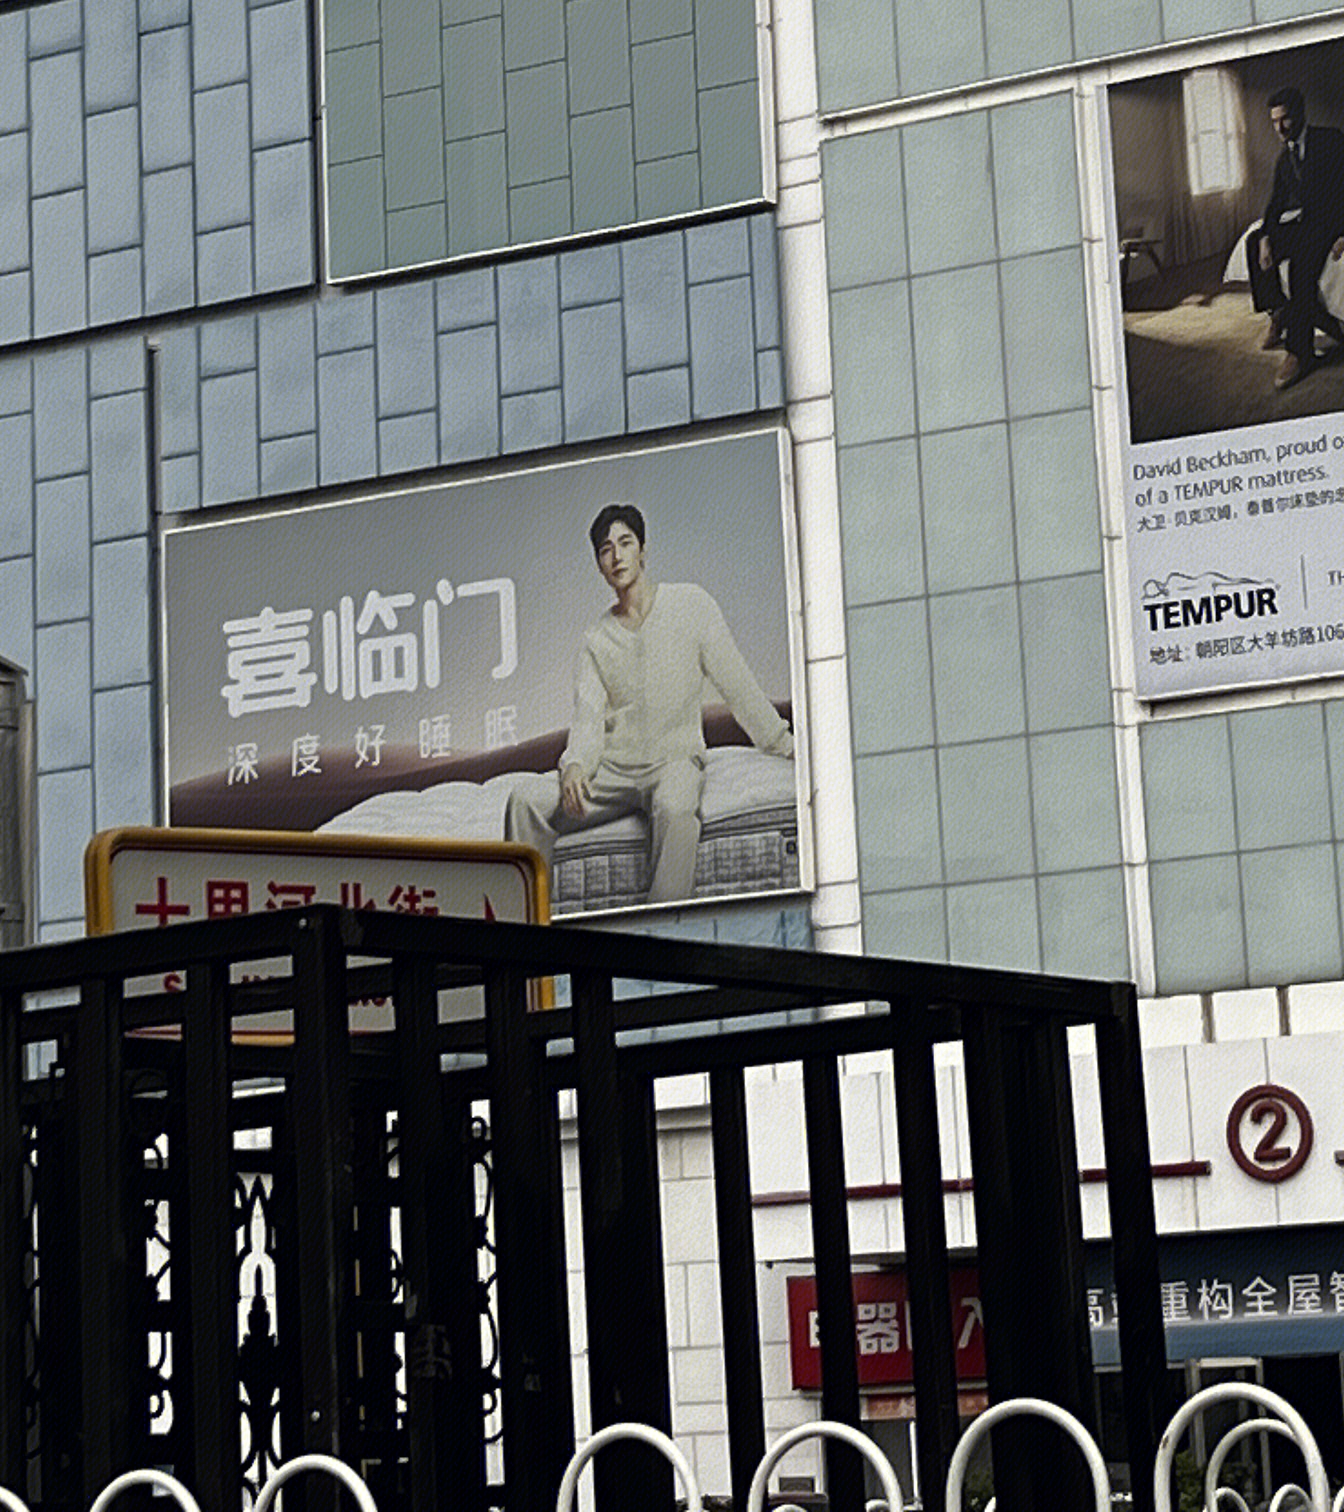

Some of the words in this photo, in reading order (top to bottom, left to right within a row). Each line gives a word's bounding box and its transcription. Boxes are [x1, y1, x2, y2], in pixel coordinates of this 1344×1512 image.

[1132, 457, 1182, 481] David
[1186, 446, 1272, 474] Beckham,
[1276, 434, 1328, 463] proud
[1135, 486, 1153, 508] of
[1158, 488, 1170, 504] a
[1174, 475, 1244, 502] TEMPUR
[1247, 465, 1331, 490] mattress.
[1143, 587, 1278, 632] TEMPUR
[221, 577, 520, 719] 喜临门
[227, 705, 519, 786] 深度好睡眠
